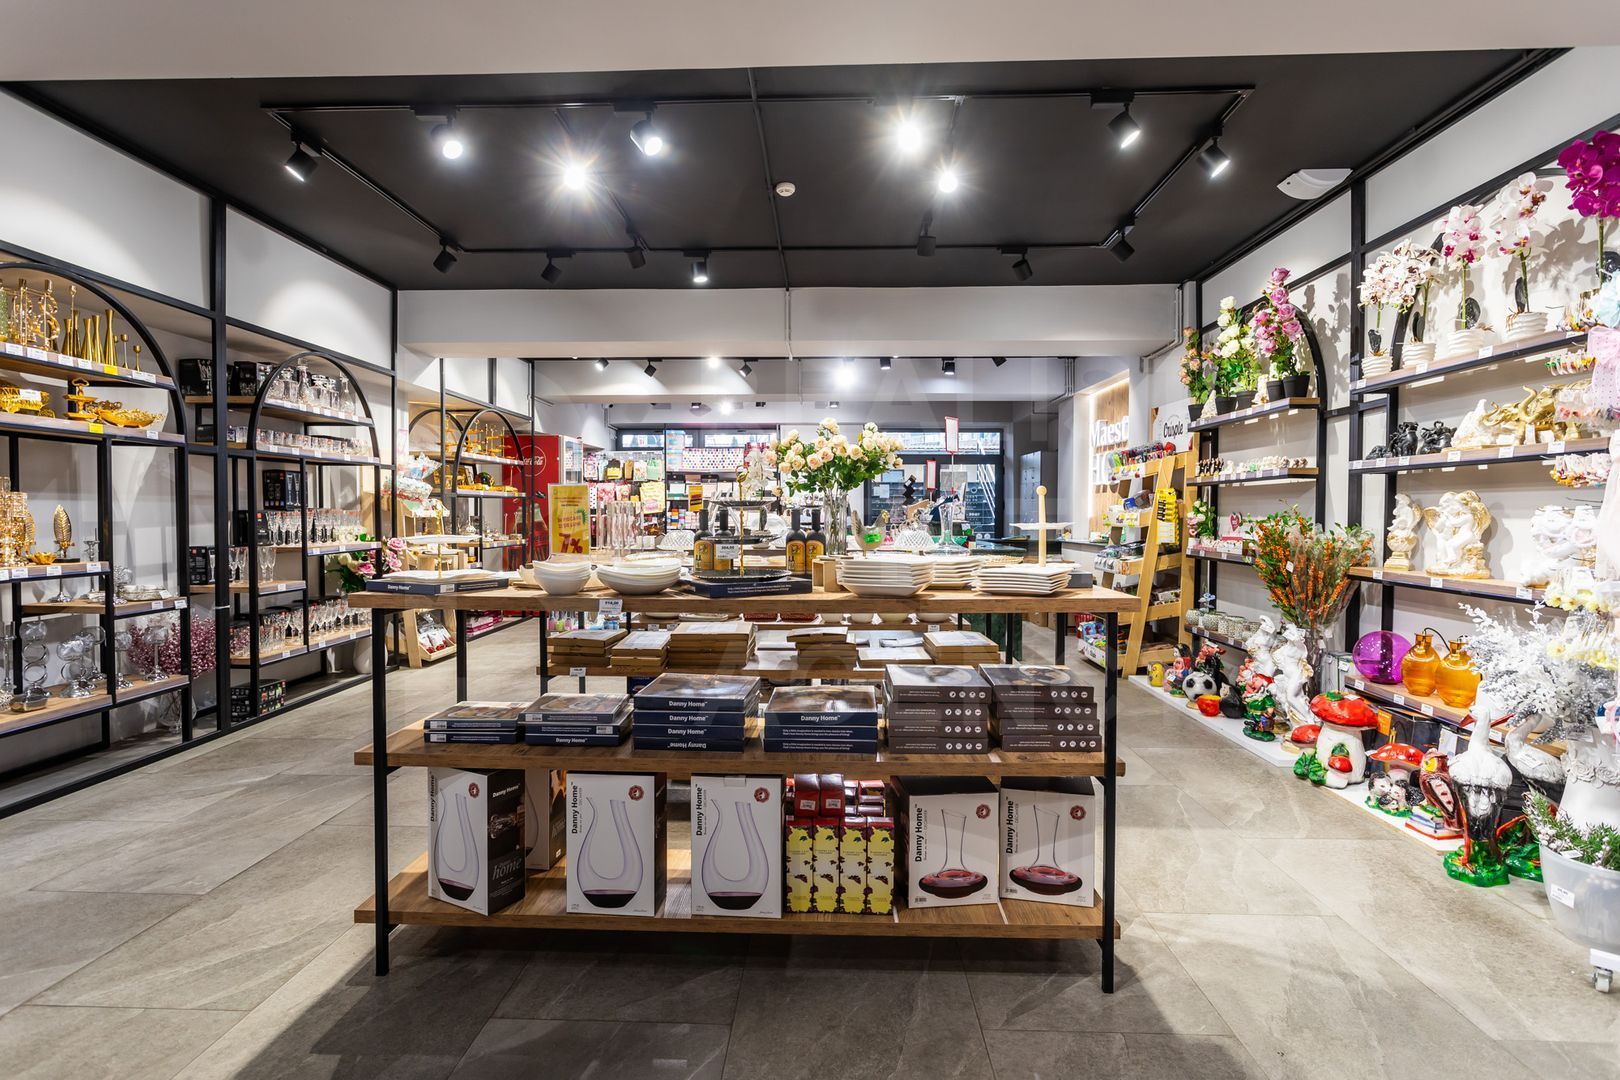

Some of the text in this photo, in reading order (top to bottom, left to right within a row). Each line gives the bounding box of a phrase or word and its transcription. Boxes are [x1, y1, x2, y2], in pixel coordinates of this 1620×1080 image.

[669, 700, 687, 709] Danny
[669, 715, 687, 723] Danny
[668, 728, 686, 736] Danny
[571, 809, 579, 834] Danny
[696, 811, 704, 836] Danny
[914, 835, 924, 862] Danny
[1006, 827, 1015, 854] Danny
